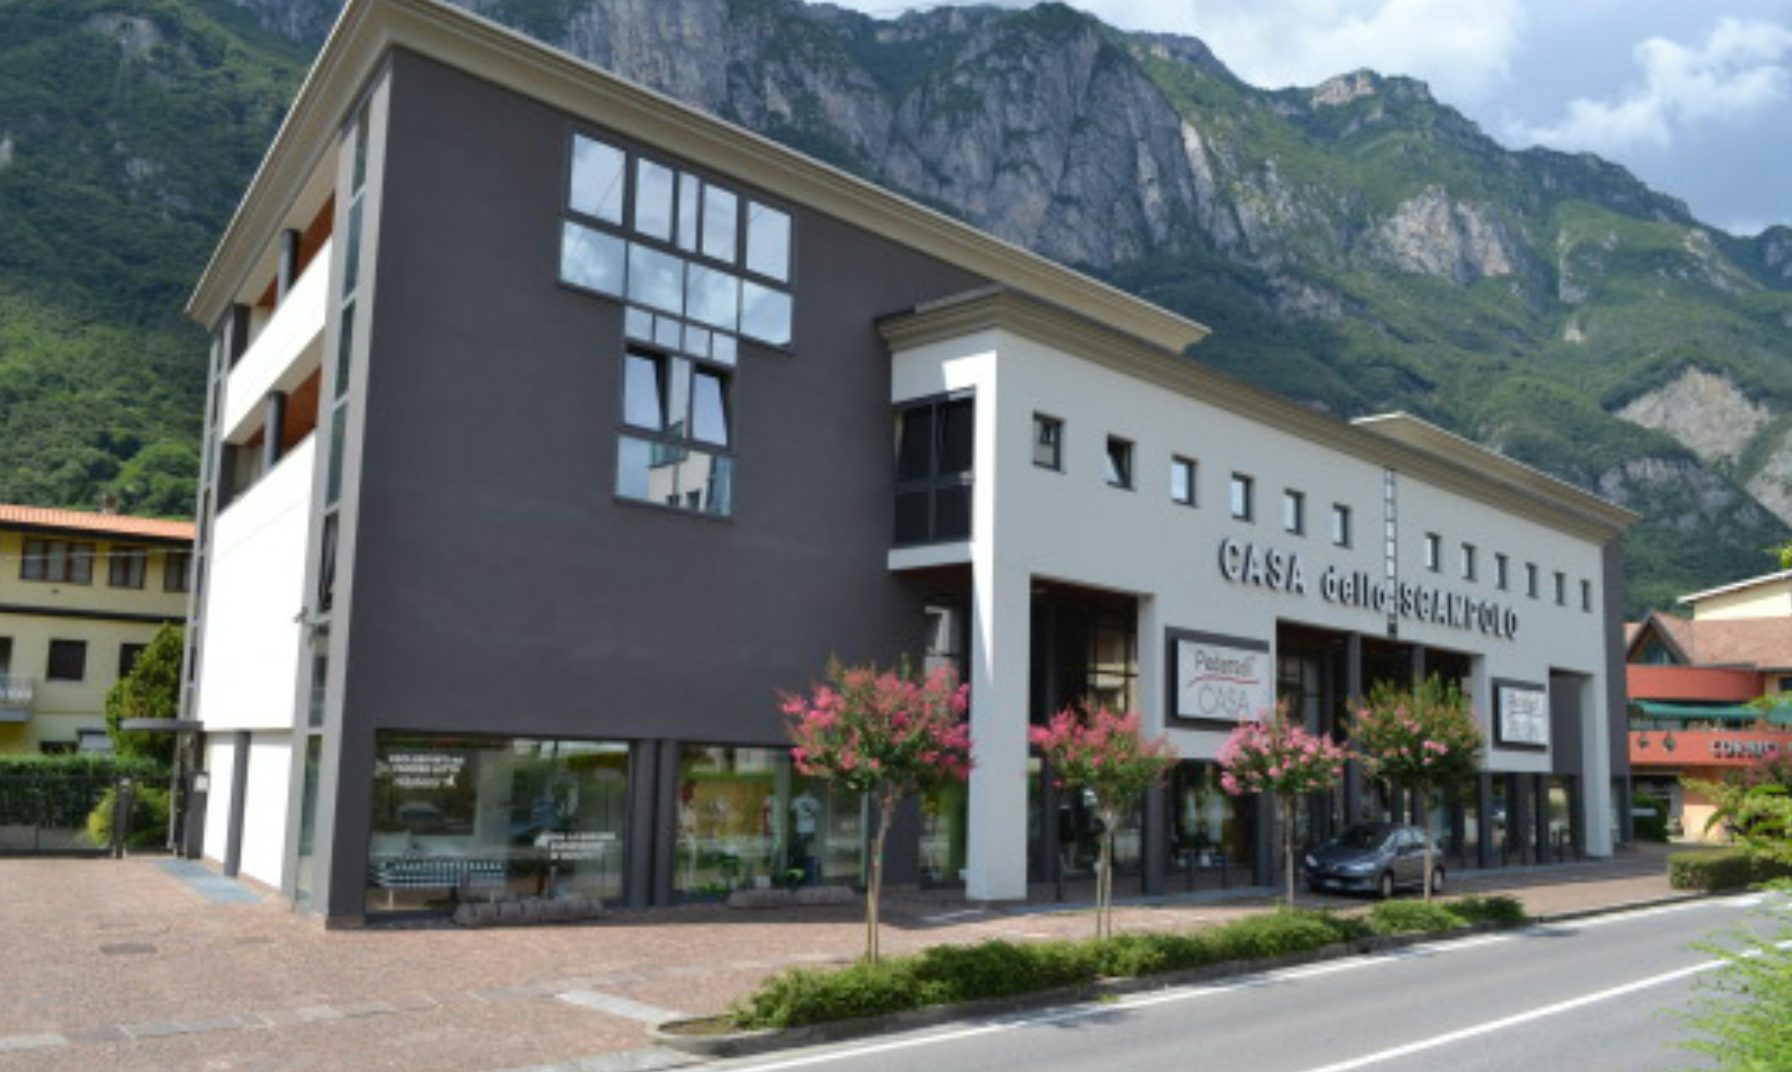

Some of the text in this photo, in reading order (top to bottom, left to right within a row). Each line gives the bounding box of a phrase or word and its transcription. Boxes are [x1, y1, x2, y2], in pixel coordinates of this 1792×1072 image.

[1218, 539, 1518, 640] CASA dello SCAMPOLO
